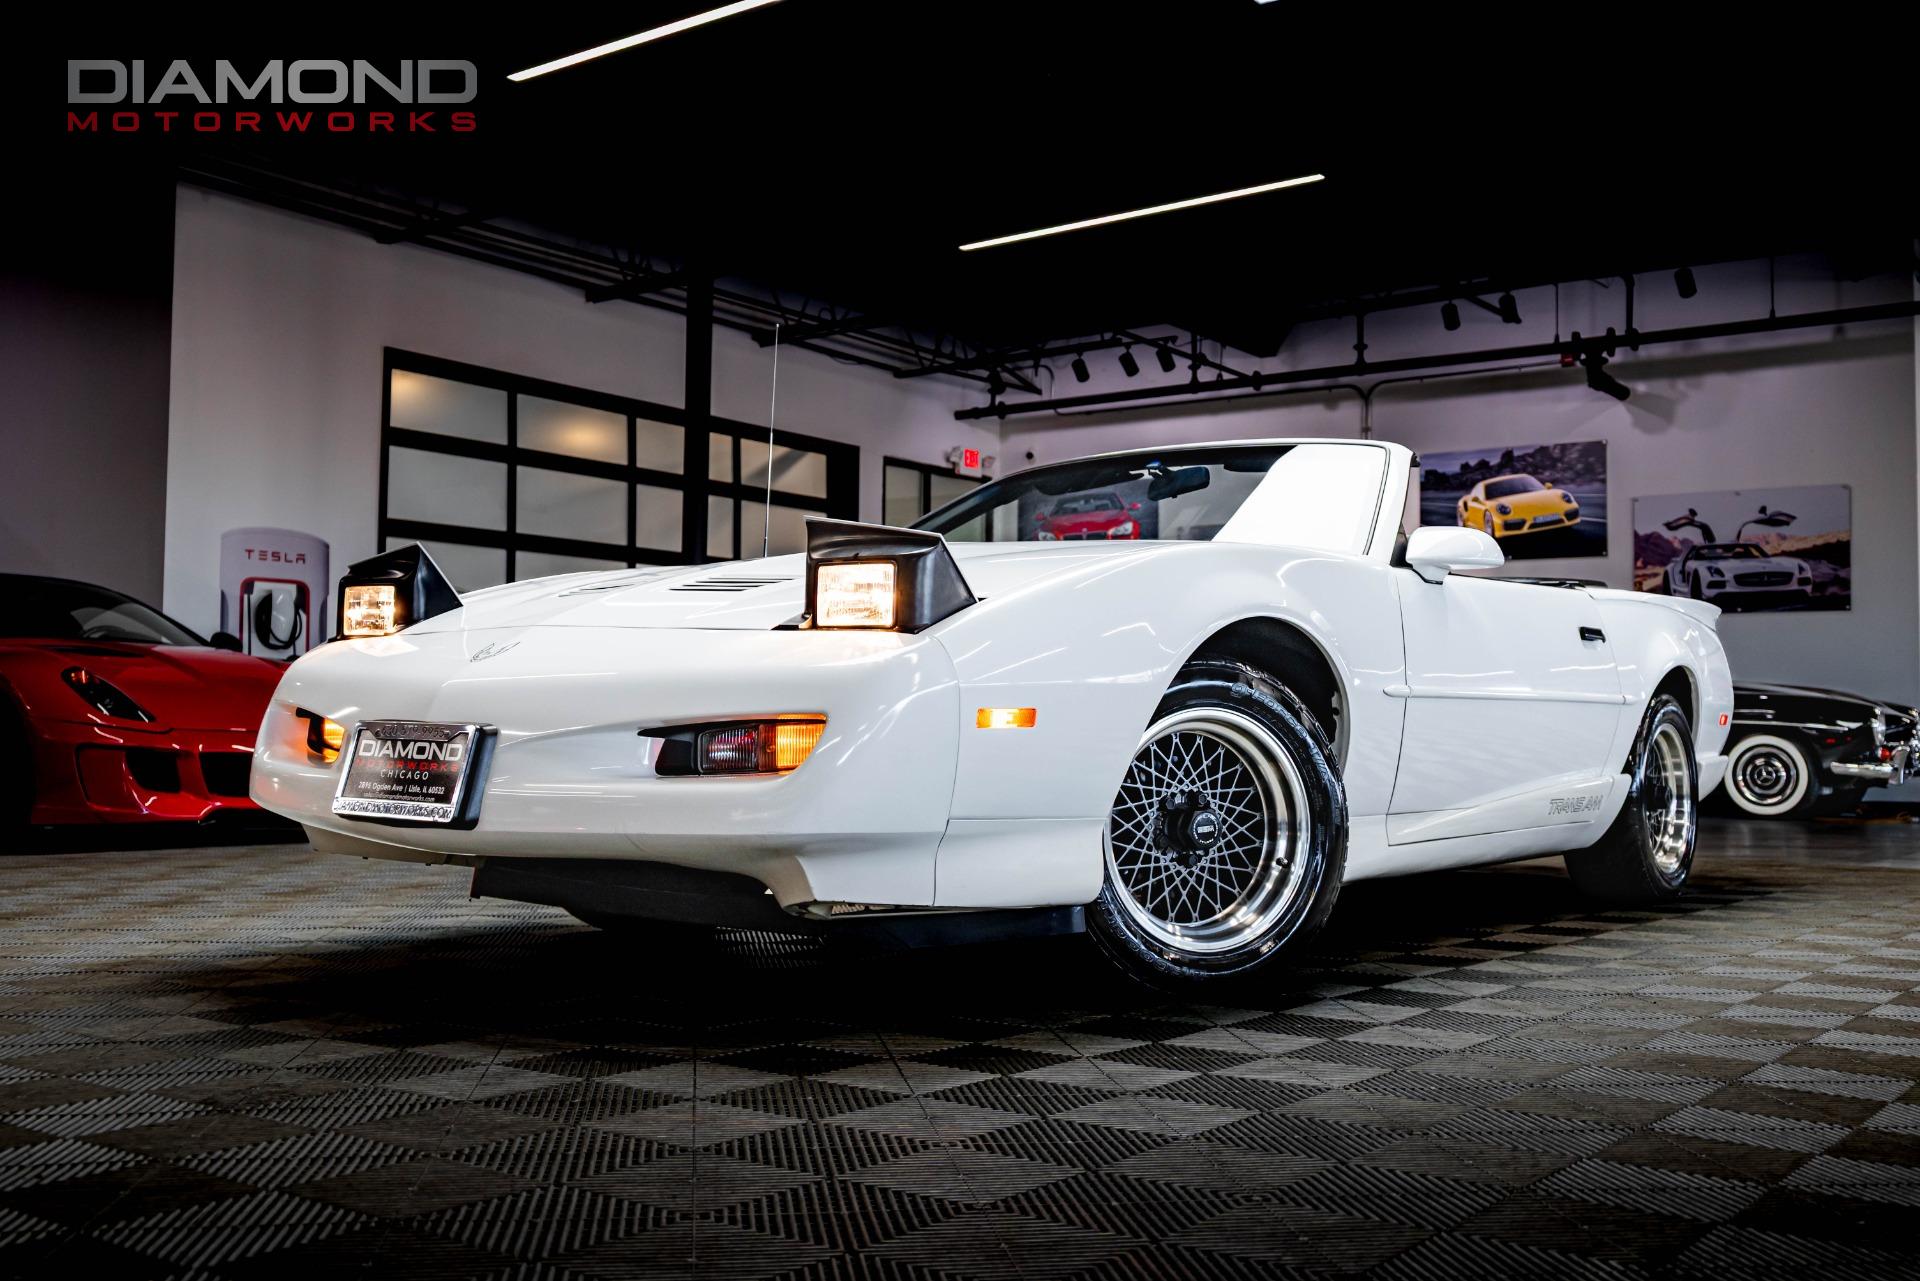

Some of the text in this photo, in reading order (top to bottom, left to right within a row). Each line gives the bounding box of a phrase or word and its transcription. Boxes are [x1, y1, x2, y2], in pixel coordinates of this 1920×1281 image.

[245, 549, 306, 564] TESLA
[358, 739, 462, 761] DIAMOND
[355, 758, 459, 773] MOTORWORKS
[380, 768, 429, 780] CHICAGO
[372, 782, 391, 791] Ogden
